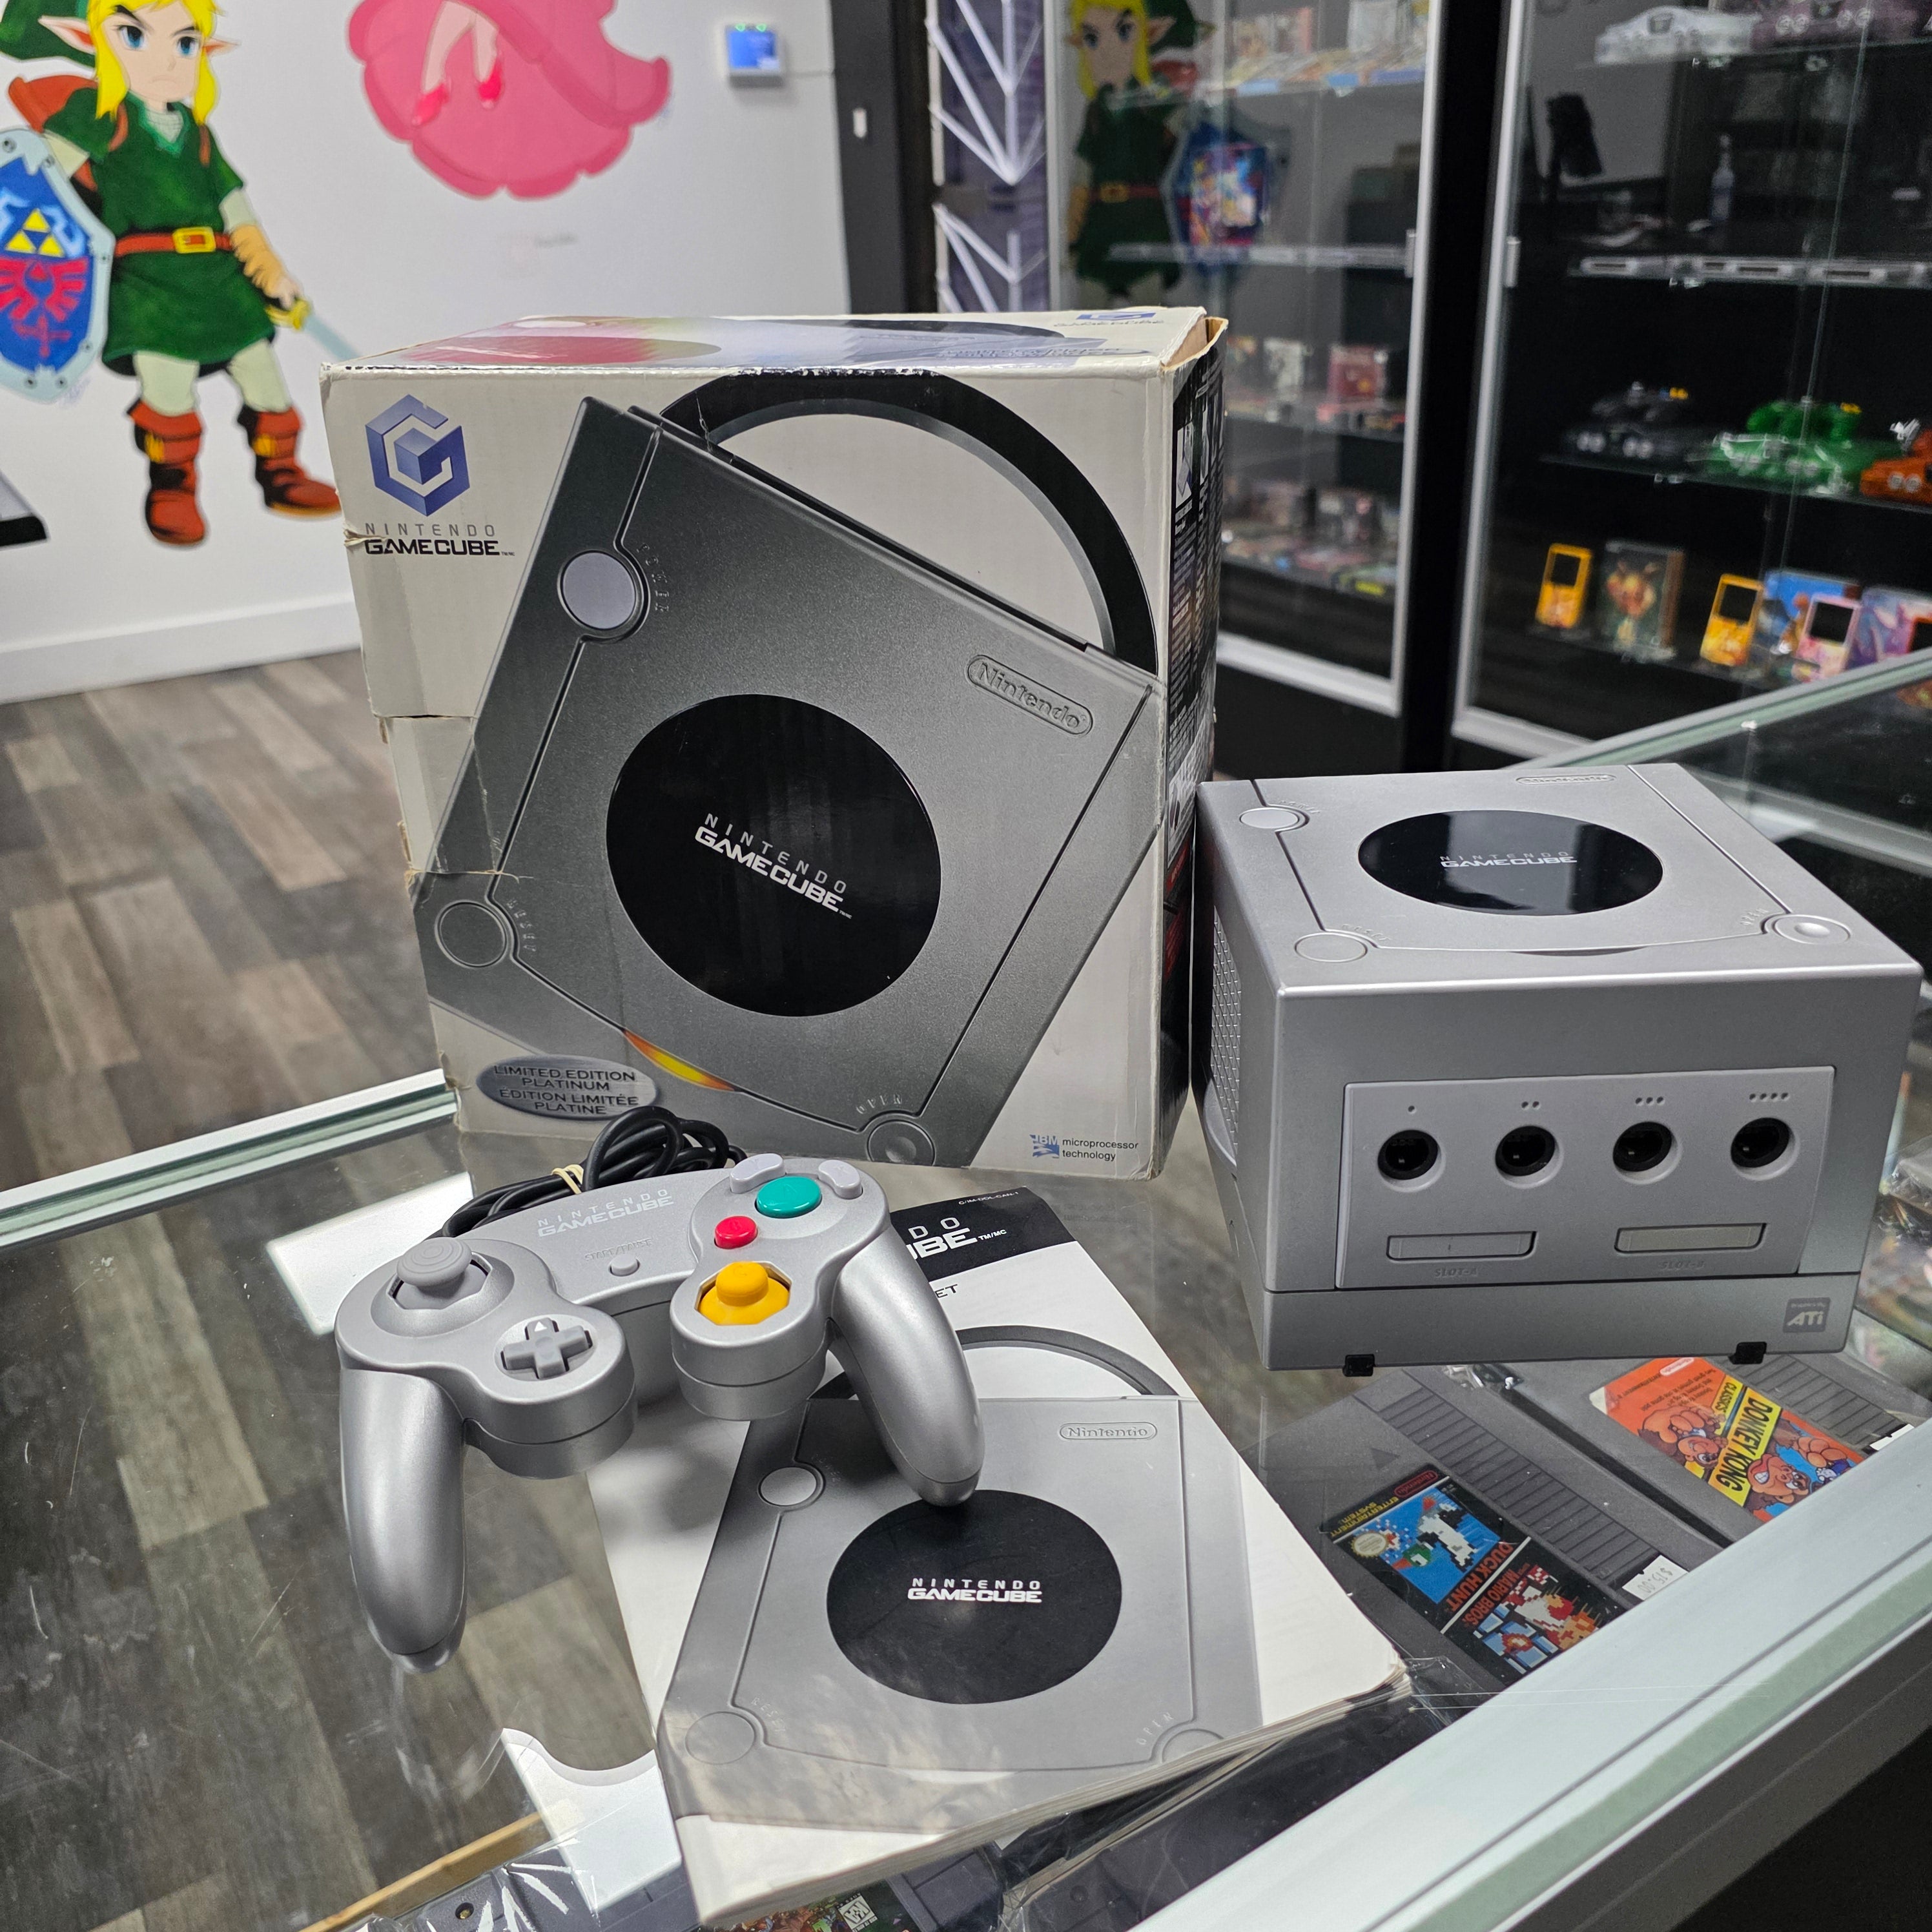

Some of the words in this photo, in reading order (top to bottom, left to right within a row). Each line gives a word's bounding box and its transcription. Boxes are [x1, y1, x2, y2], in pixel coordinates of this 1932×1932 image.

[365, 523, 495, 537] NINTENDO
[365, 539, 500, 556] GAMECUBE
[977, 662, 1081, 728] Nintendo
[704, 813, 847, 894] NINTENDO
[1439, 851, 1569, 861] NINTENDO
[1440, 856, 1577, 868] GAMECUBE
[695, 826, 843, 912] GAMECUBE
[494, 1065, 560, 1078] LIMITED
[566, 1069, 636, 1082] EDITION
[521, 1078, 610, 1091] PLATINUM
[499, 1087, 566, 1102] ÉDITION
[571, 1093, 639, 1105] LIMITÉE
[534, 1102, 607, 1115] PLATINE
[1062, 1138, 1139, 1149] microprocessor
[1062, 1150, 1116, 1162] technology
[538, 1189, 668, 1227] NINTENDO
[538, 1196, 674, 1237] GAMECUBE
[978, 1229, 1007, 1241] TM/MC
[1715, 1382, 1737, 1413] CLASSICS
[1067, 1426, 1148, 1437] Nintendo
[1731, 1397, 1773, 1456] DONKEY
[1715, 1446, 1754, 1492] KONG
[1475, 1541, 1514, 1579] DUCK
[912, 1577, 1040, 1590] NINTENDO
[1487, 1568, 1520, 1601] MARIO
[1638, 1567, 1673, 1593] $15.00
[907, 1588, 1043, 1603] GAMECUBE
[1446, 1572, 1483, 1612] HUNT
[1461, 1596, 1495, 1625] BROS.
